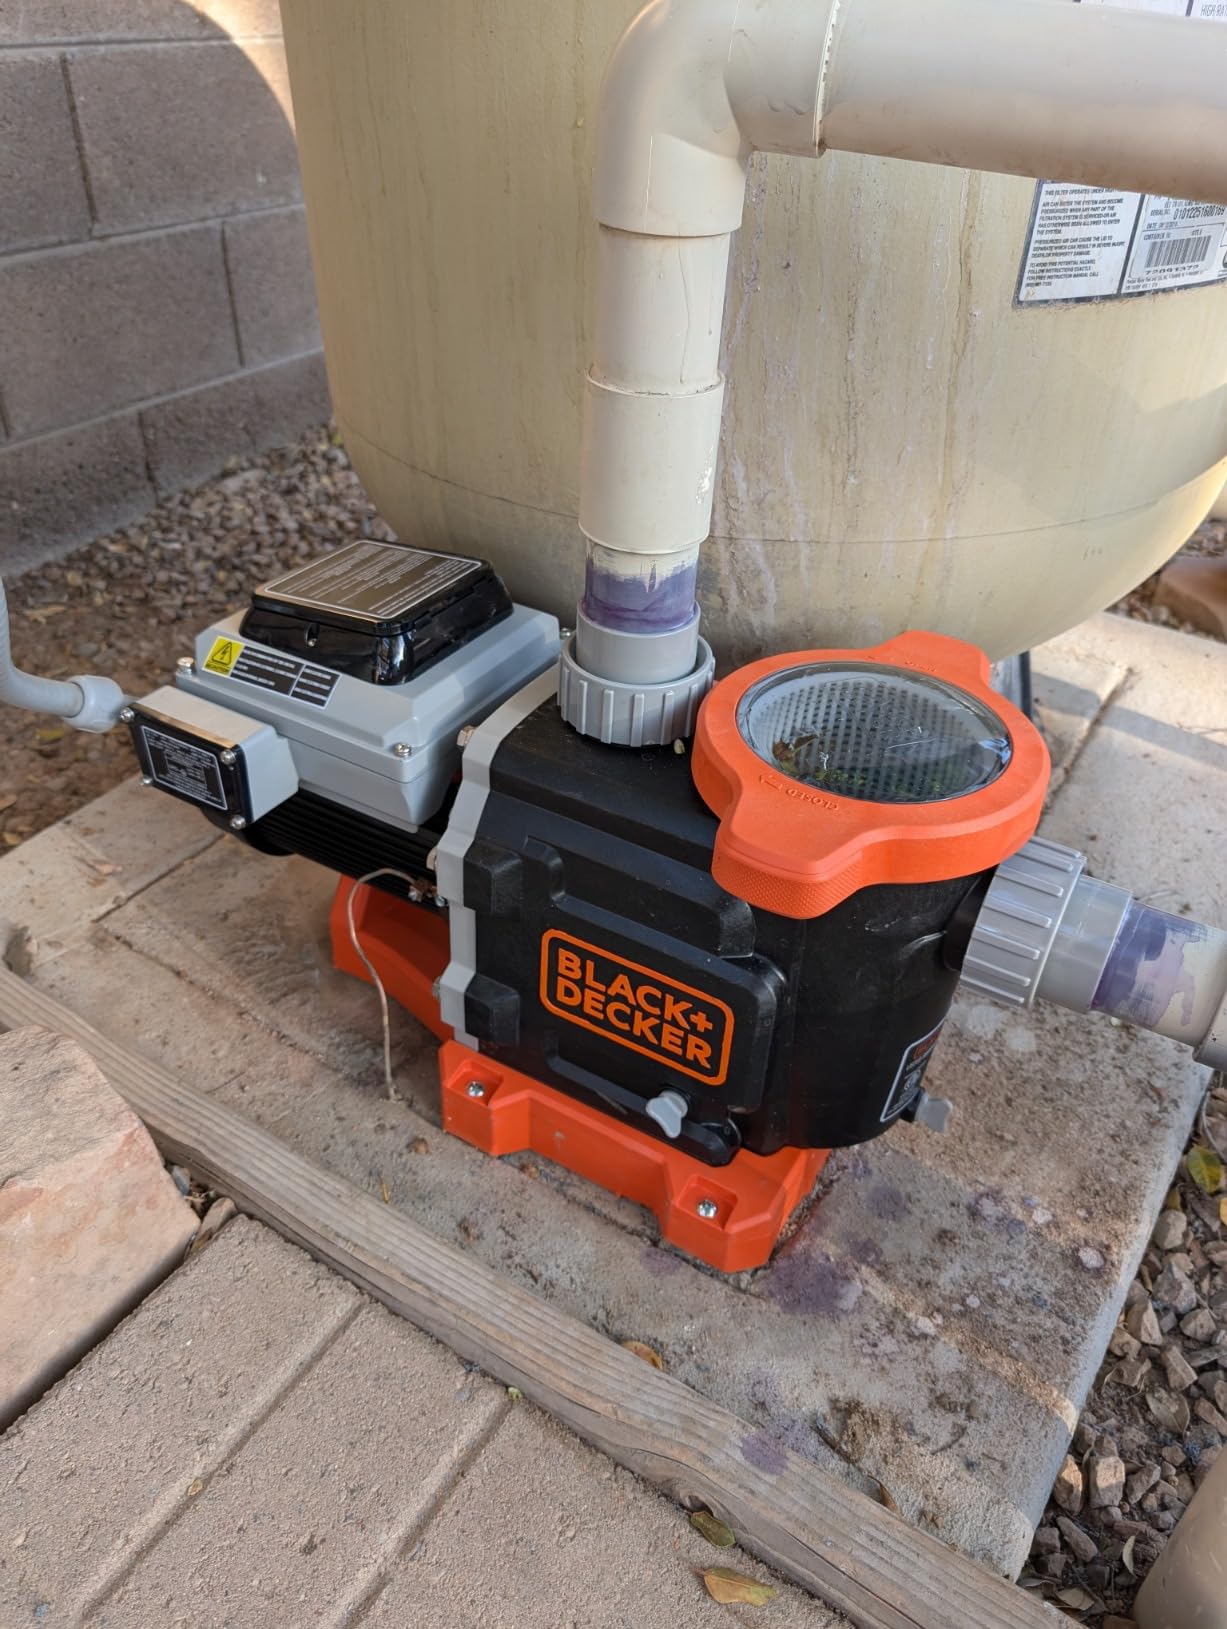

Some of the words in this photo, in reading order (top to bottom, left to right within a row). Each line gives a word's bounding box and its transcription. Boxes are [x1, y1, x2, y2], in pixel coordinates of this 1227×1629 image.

[786, 788, 839, 810] CLOSED
[556, 976, 712, 1069] DECKER
[558, 947, 713, 1032] BLACK+
